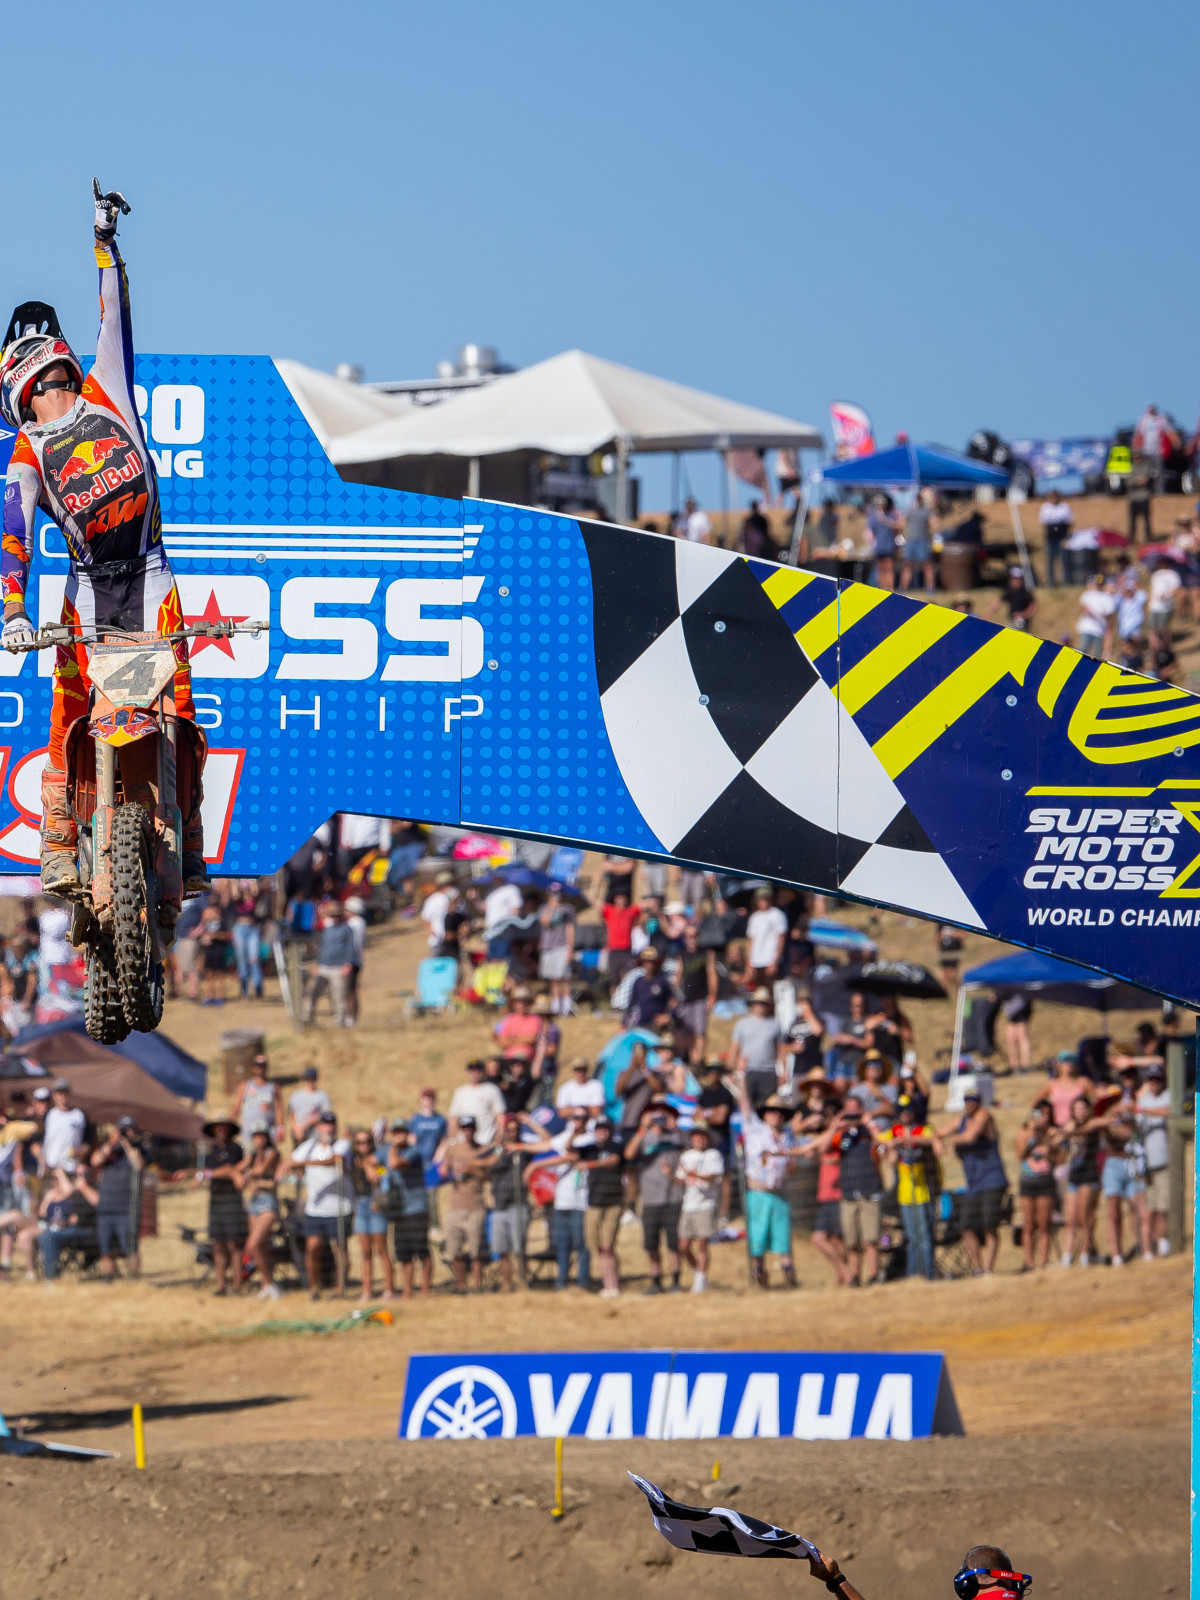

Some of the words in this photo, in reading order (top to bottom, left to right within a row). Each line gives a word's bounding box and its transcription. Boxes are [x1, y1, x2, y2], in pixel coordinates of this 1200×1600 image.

[62, 476, 106, 515] Red
[102, 450, 144, 492] Bull
[85, 491, 148, 542] KTM
[103, 653, 157, 696] 4
[1024, 808, 1184, 834] SUPER
[1034, 836, 1175, 862] MOTO
[1023, 865, 1177, 891] CROSS
[1027, 908, 1115, 926] WORLD
[529, 1373, 913, 1440] YAMAHA
